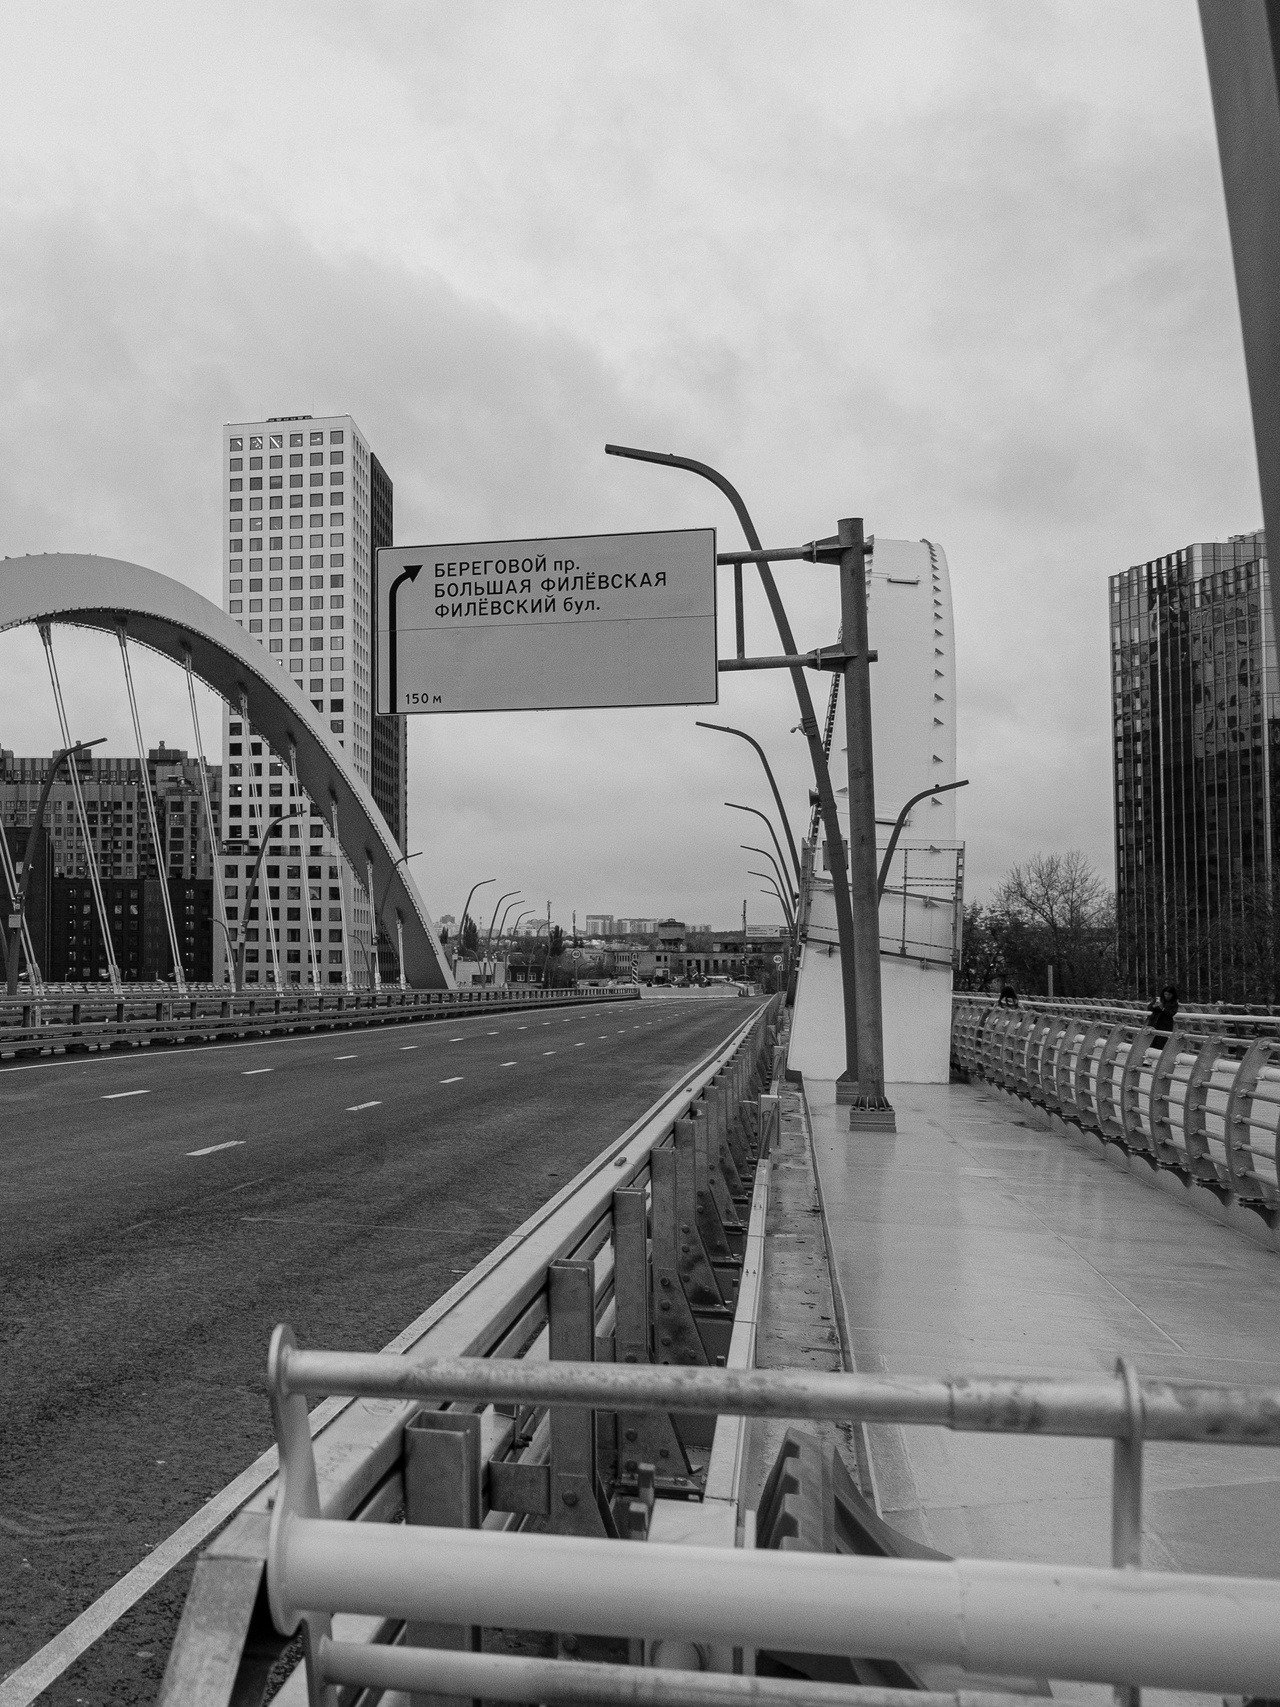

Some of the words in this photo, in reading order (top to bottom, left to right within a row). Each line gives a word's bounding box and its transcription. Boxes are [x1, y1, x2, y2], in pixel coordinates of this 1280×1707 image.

[434, 553, 547, 578] БЕРЕГОВОЙ
[553, 559, 580, 573] пр.
[434, 578, 531, 598] БОЛЬШАЯ
[540, 571, 667, 593] ФИЛЁВСКАЯ
[434, 594, 556, 618] ФИЛЁВСКИЙ
[563, 596, 601, 614] бул.
[405, 692, 429, 705] 150
[432, 695, 442, 704] м
